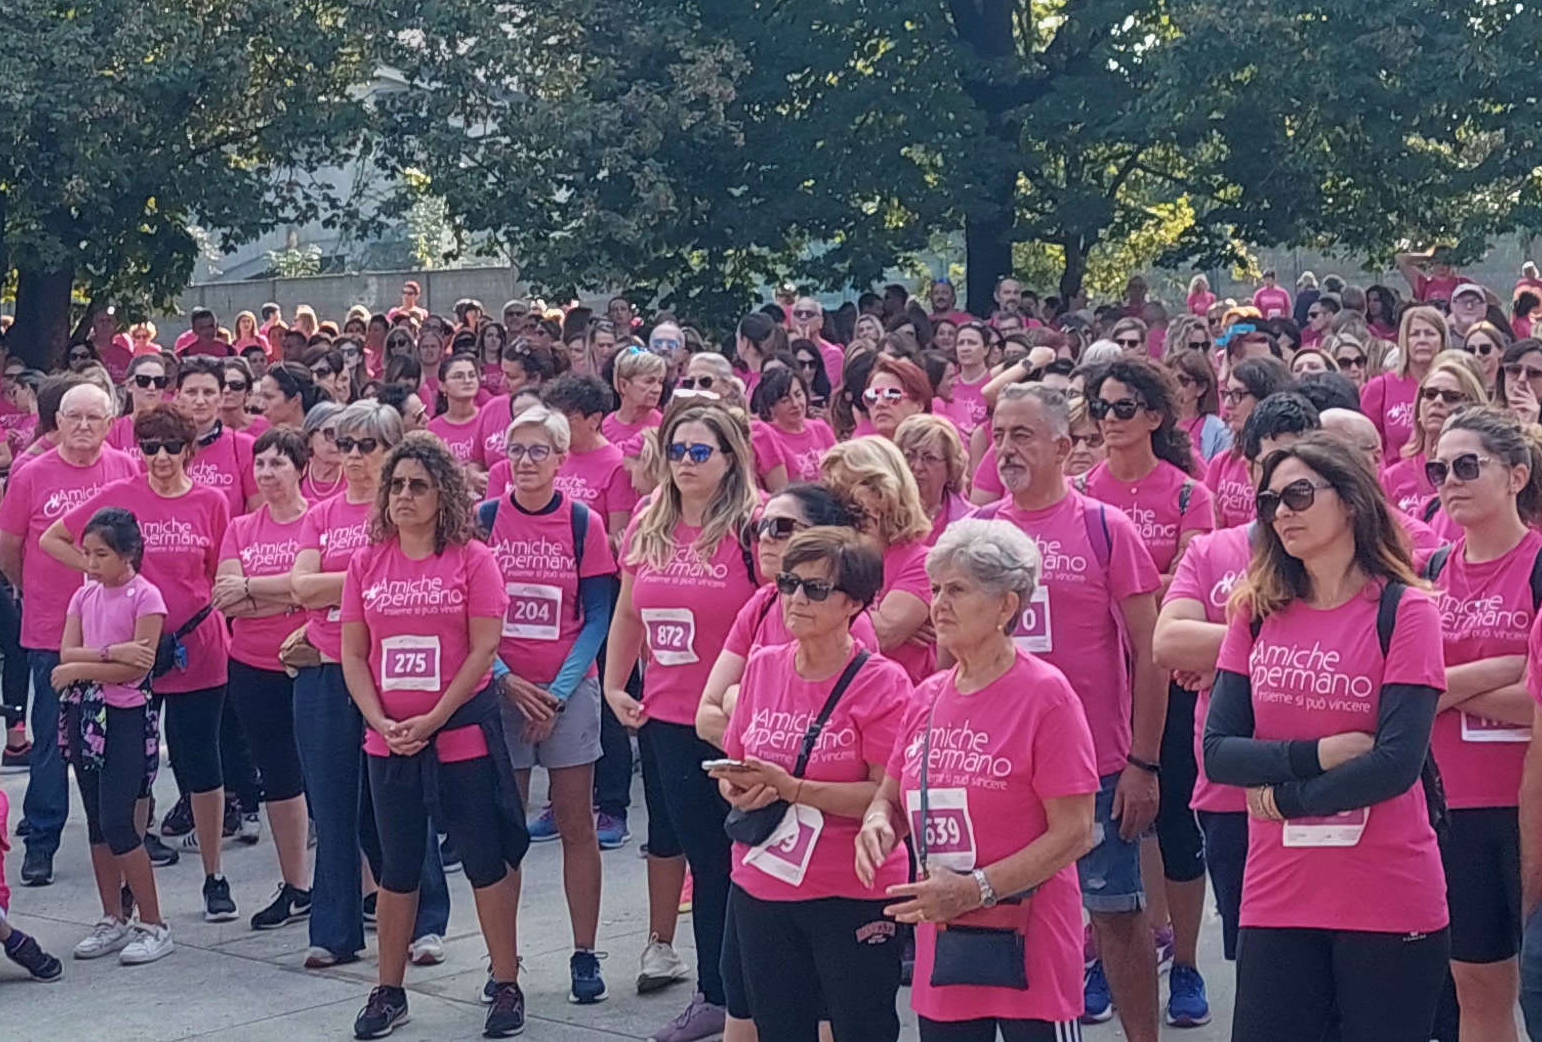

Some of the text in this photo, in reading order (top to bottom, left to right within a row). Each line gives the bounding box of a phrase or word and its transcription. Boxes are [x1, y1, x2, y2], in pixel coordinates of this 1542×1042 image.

[60, 485, 102, 502] Amich
[1218, 479, 1255, 498] Amic
[499, 535, 563, 556] Amiche
[379, 574, 443, 595] Amiche
[379, 589, 463, 612] permano
[514, 601, 551, 622] 204
[1440, 610, 1529, 629] ermano
[658, 624, 685, 647] 872
[394, 652, 427, 673] 275
[1255, 640, 1340, 672] Amiche
[1253, 663, 1372, 697] permano
[1306, 695, 1326, 712] può
[1328, 698, 1371, 713] vincere
[930, 719, 989, 752] miche
[927, 747, 1012, 777] ermano
